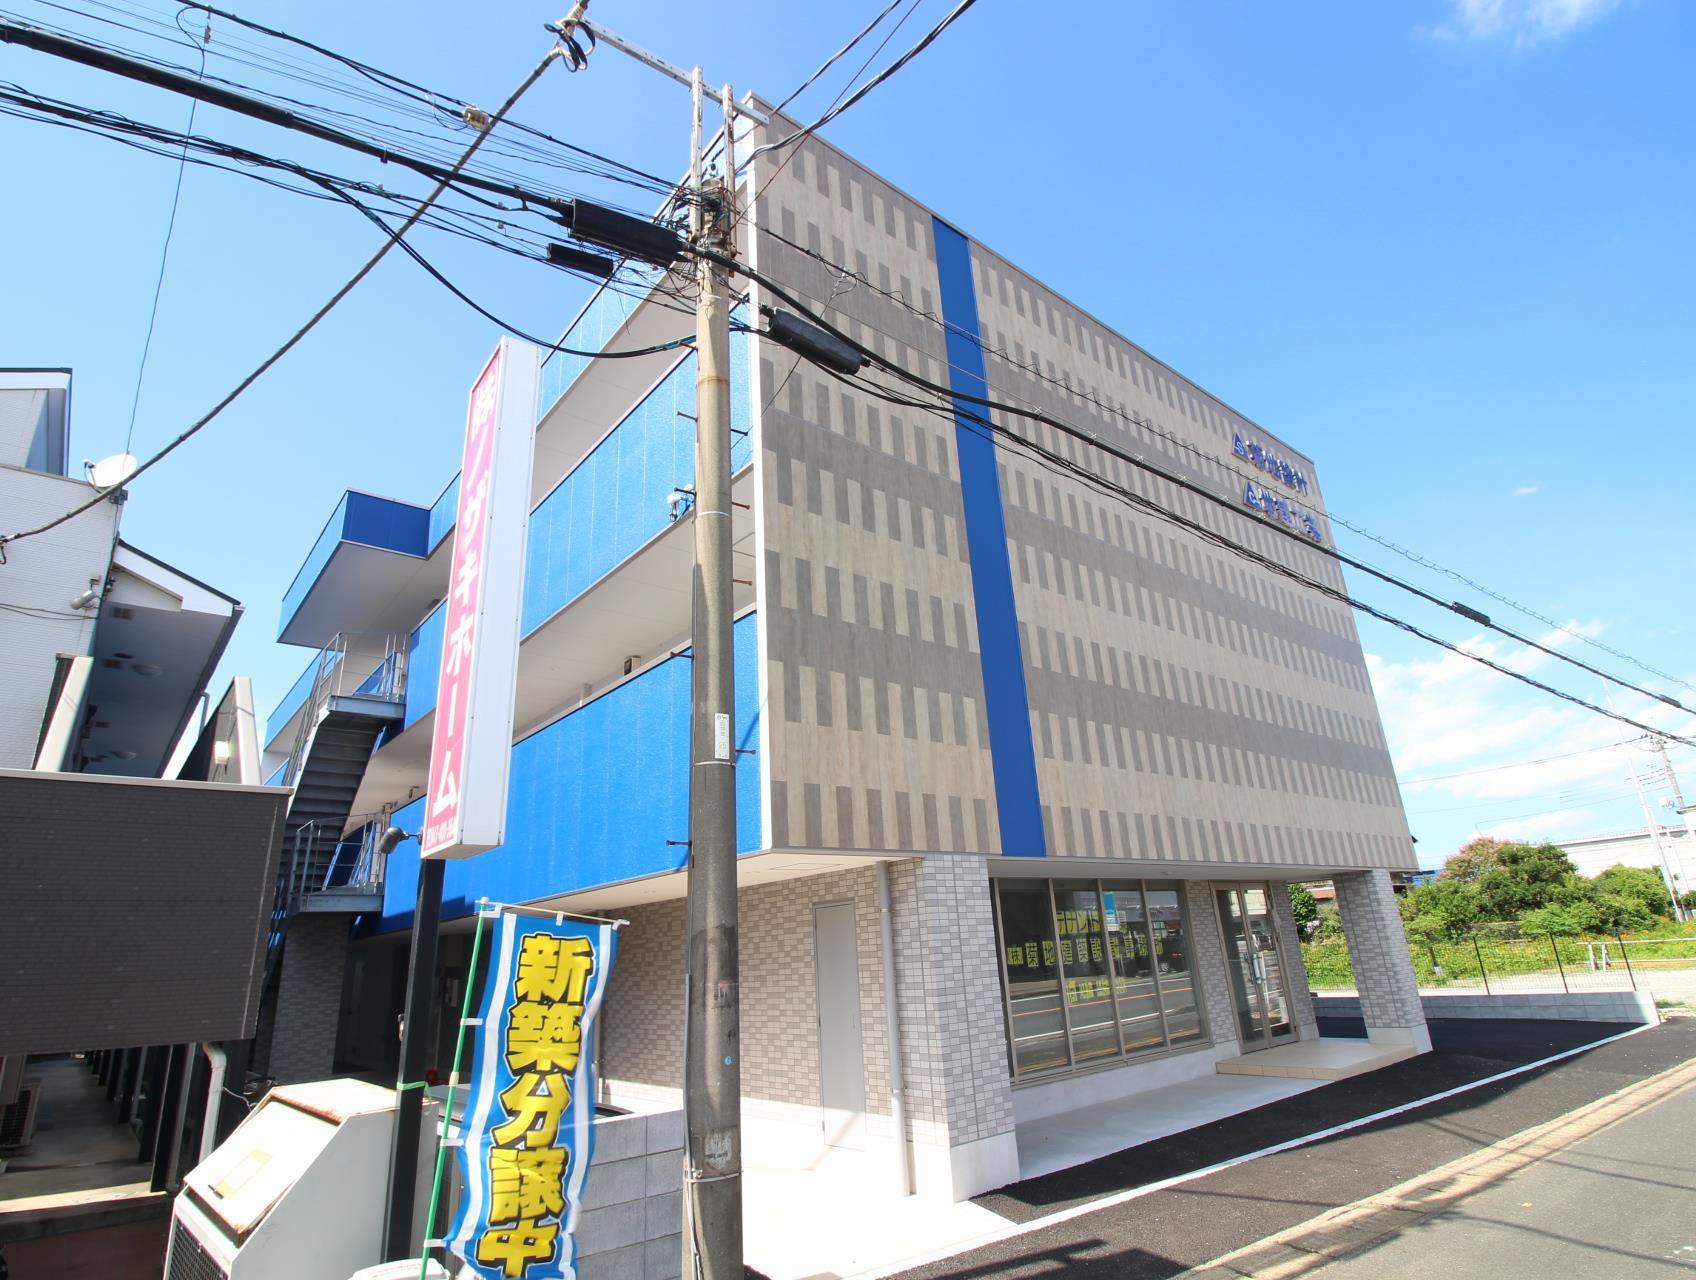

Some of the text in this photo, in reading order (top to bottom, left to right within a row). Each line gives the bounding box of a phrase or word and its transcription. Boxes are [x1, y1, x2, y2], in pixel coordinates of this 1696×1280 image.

[478, 935, 593, 1280] 新築分譲中
